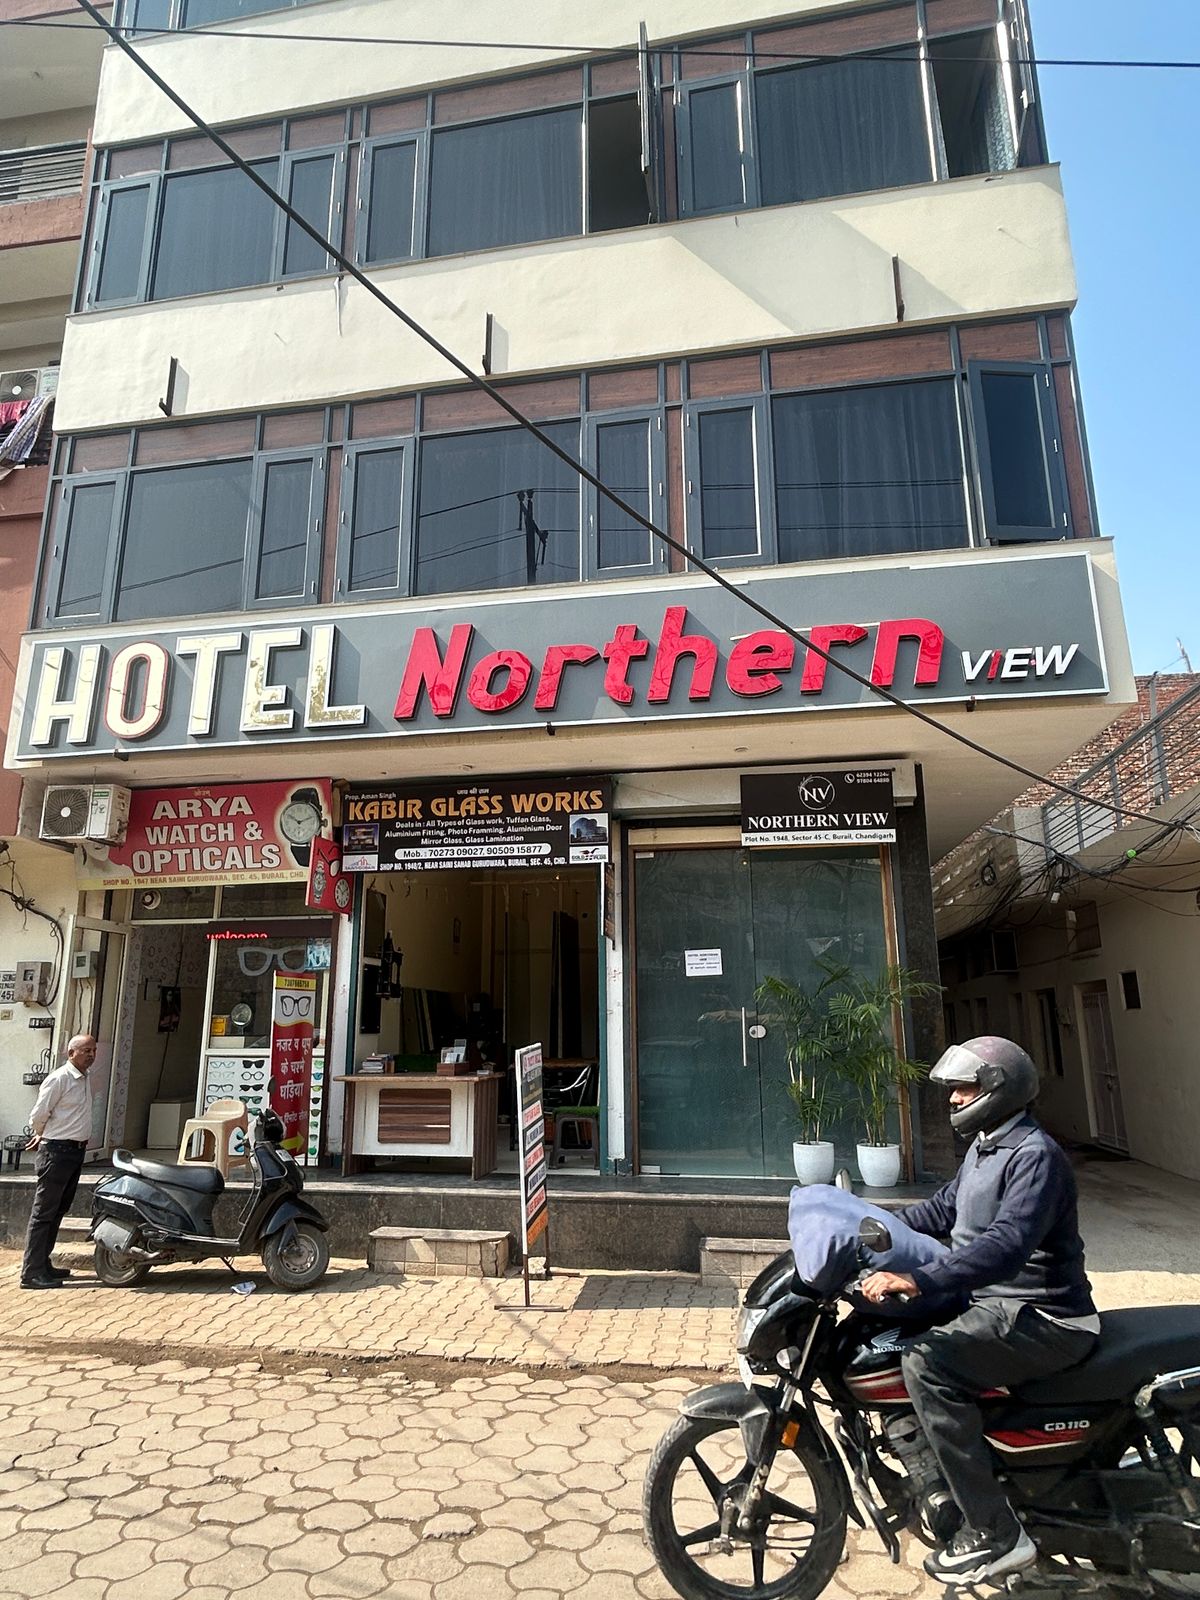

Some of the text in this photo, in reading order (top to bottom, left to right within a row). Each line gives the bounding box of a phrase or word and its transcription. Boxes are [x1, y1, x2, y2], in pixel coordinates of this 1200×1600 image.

[29, 606, 1079, 746] HOTEL Northern VIEW
[379, 791, 397, 800] Singh
[800, 783, 832, 803] NV
[152, 796, 255, 820] ARYA
[348, 790, 603, 822] KABIR GLASS WORKS
[396, 821, 414, 829] Deals
[426, 820, 436, 828] All
[437, 819, 456, 828] Types
[466, 818, 485, 826] Glass
[748, 812, 889, 830] NORTHERN VIEW
[145, 821, 263, 845] WATCH &
[448, 828, 468, 836] Photo
[507, 825, 545, 833] Aluminium
[546, 824, 563, 832] Door
[855, 832, 894, 841] Chandigarh
[466, 836, 485, 844] Glass
[485, 835, 524, 843] Lamination
[429, 848, 455, 857] 70273
[486, 846, 514, 855] 90509
[517, 846, 542, 854] 15877
[132, 844, 281, 874] OPTICALS
[380, 863, 394, 871] SHOP
[424, 861, 438, 869] NEAR
[530, 857, 543, 866] SEC.
[276, 1039, 293, 1052] नजर
